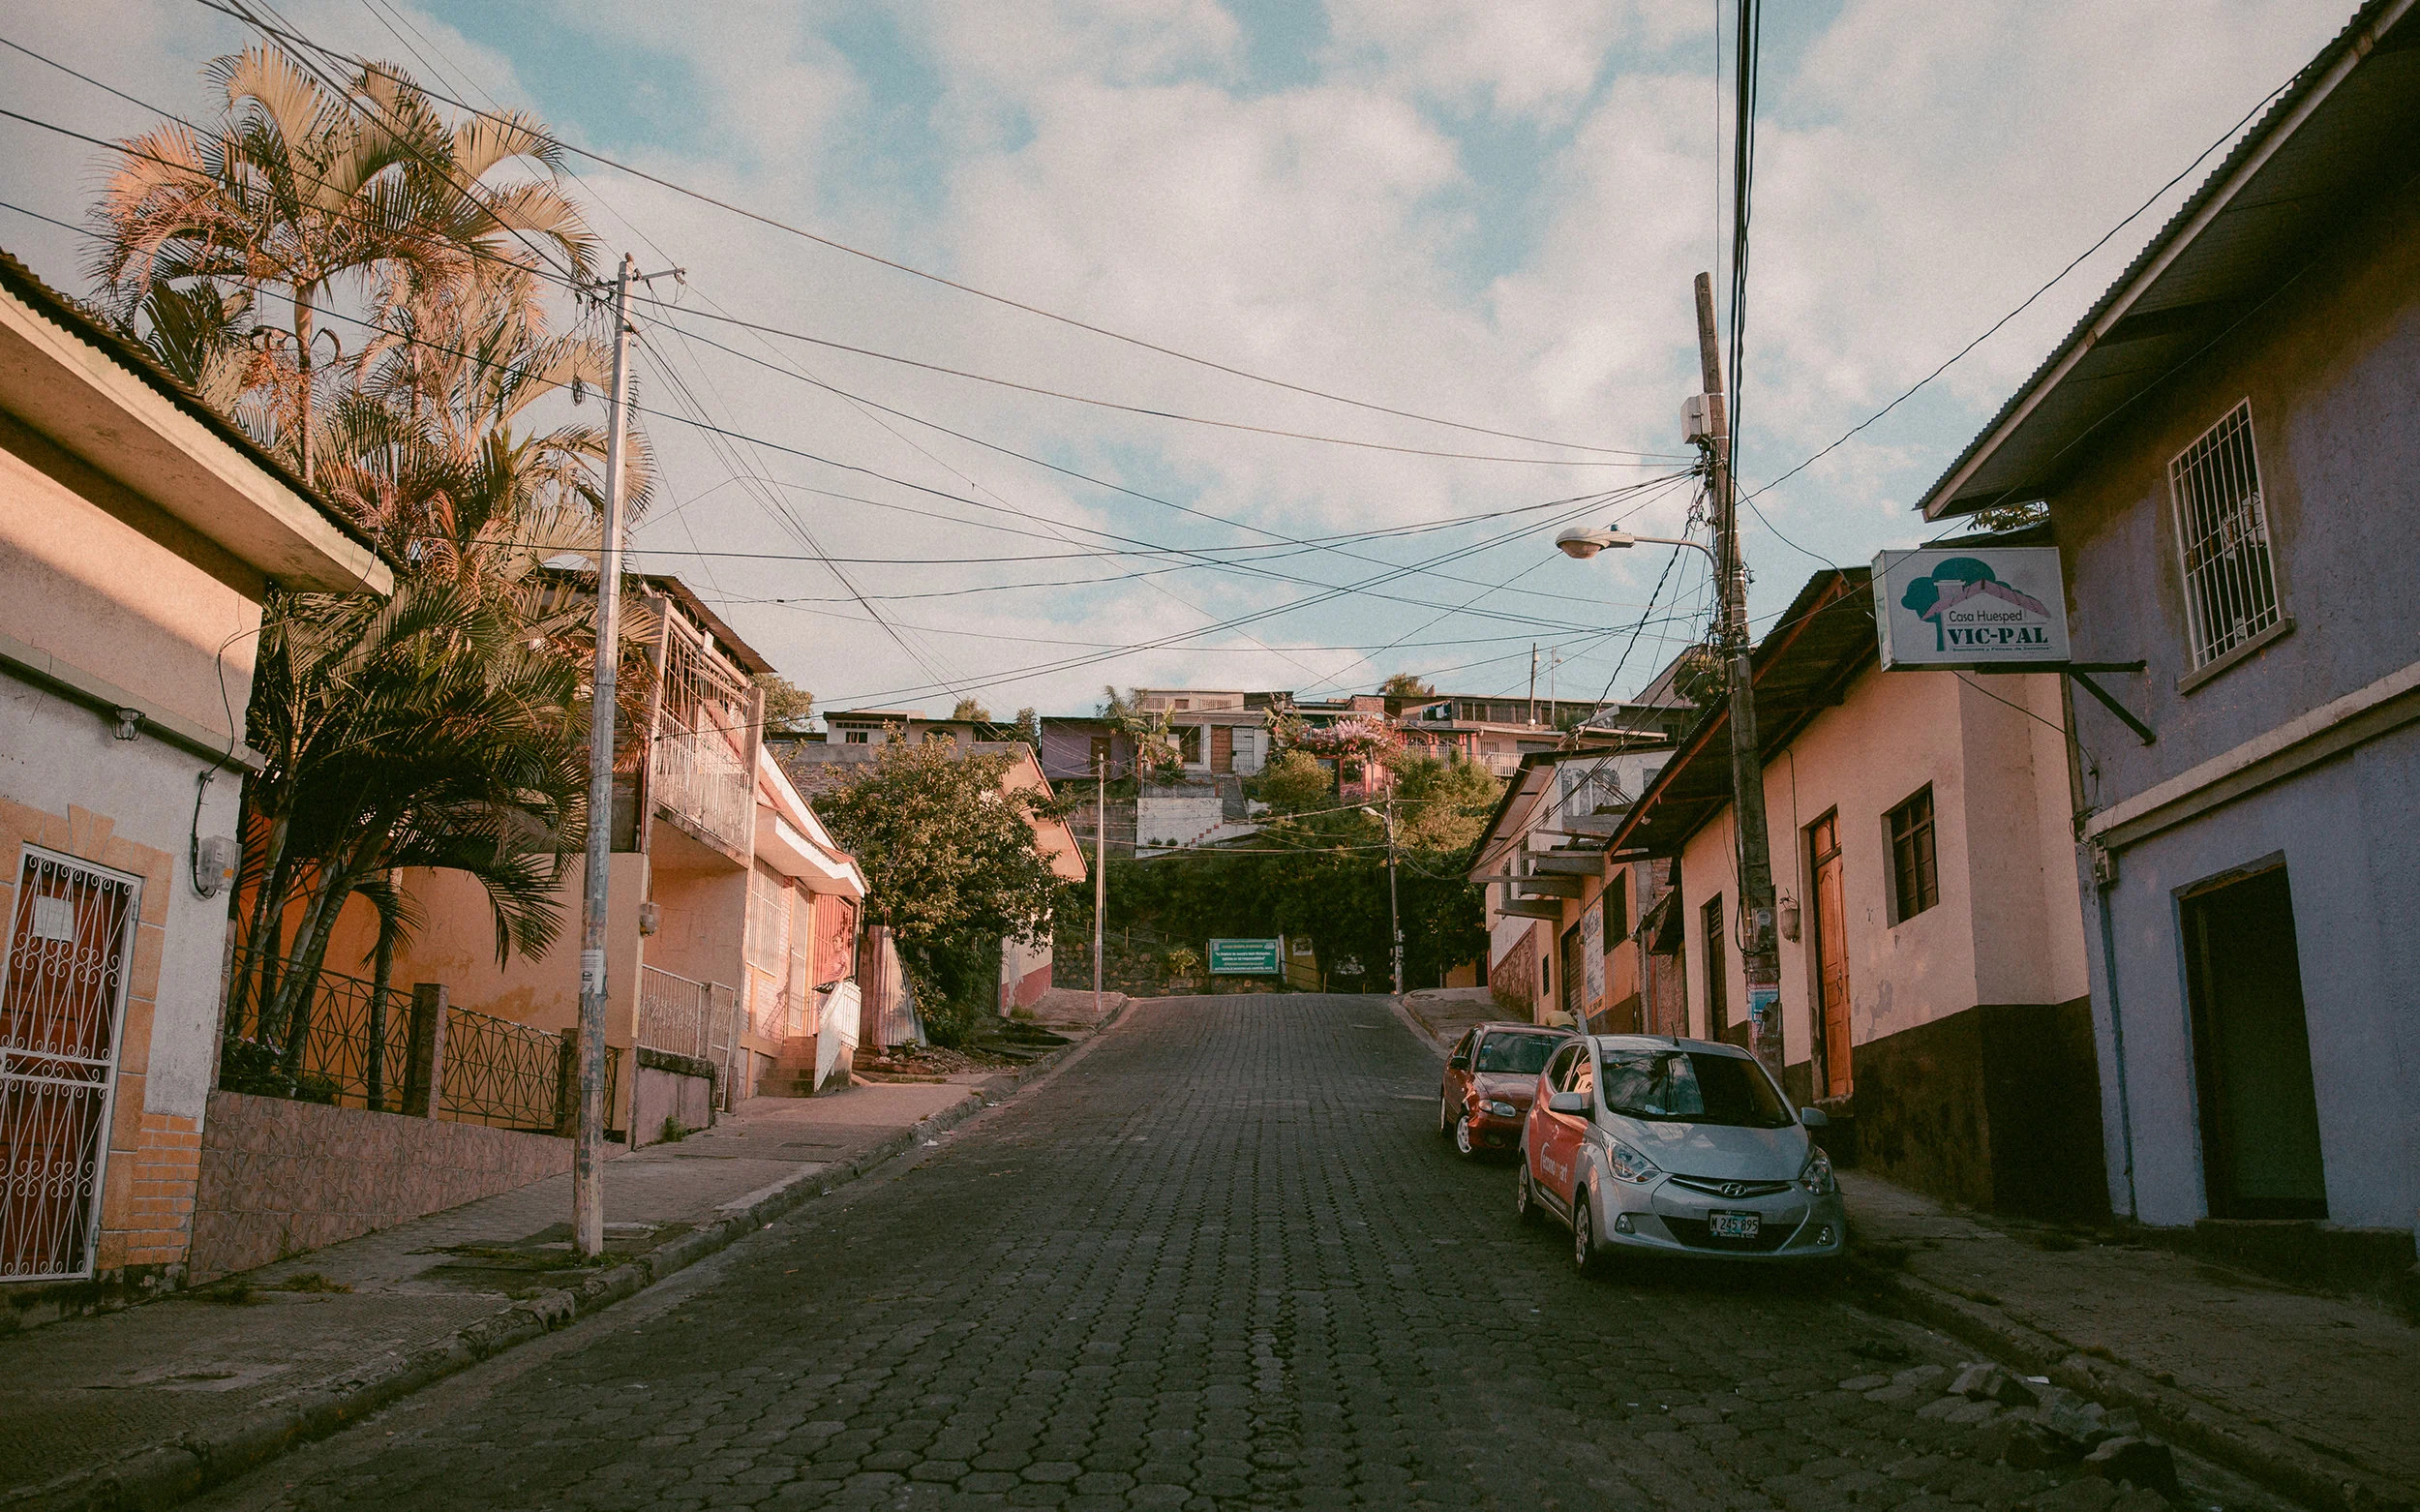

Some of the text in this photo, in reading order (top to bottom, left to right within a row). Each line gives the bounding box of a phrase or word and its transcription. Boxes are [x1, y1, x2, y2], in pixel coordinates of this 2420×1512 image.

[1950, 610, 2022, 623] Casa Huesped
[1948, 627, 2048, 645] VIC-PAL
[1720, 1217, 1739, 1230] 245
[1740, 1219, 1758, 1231] 895
